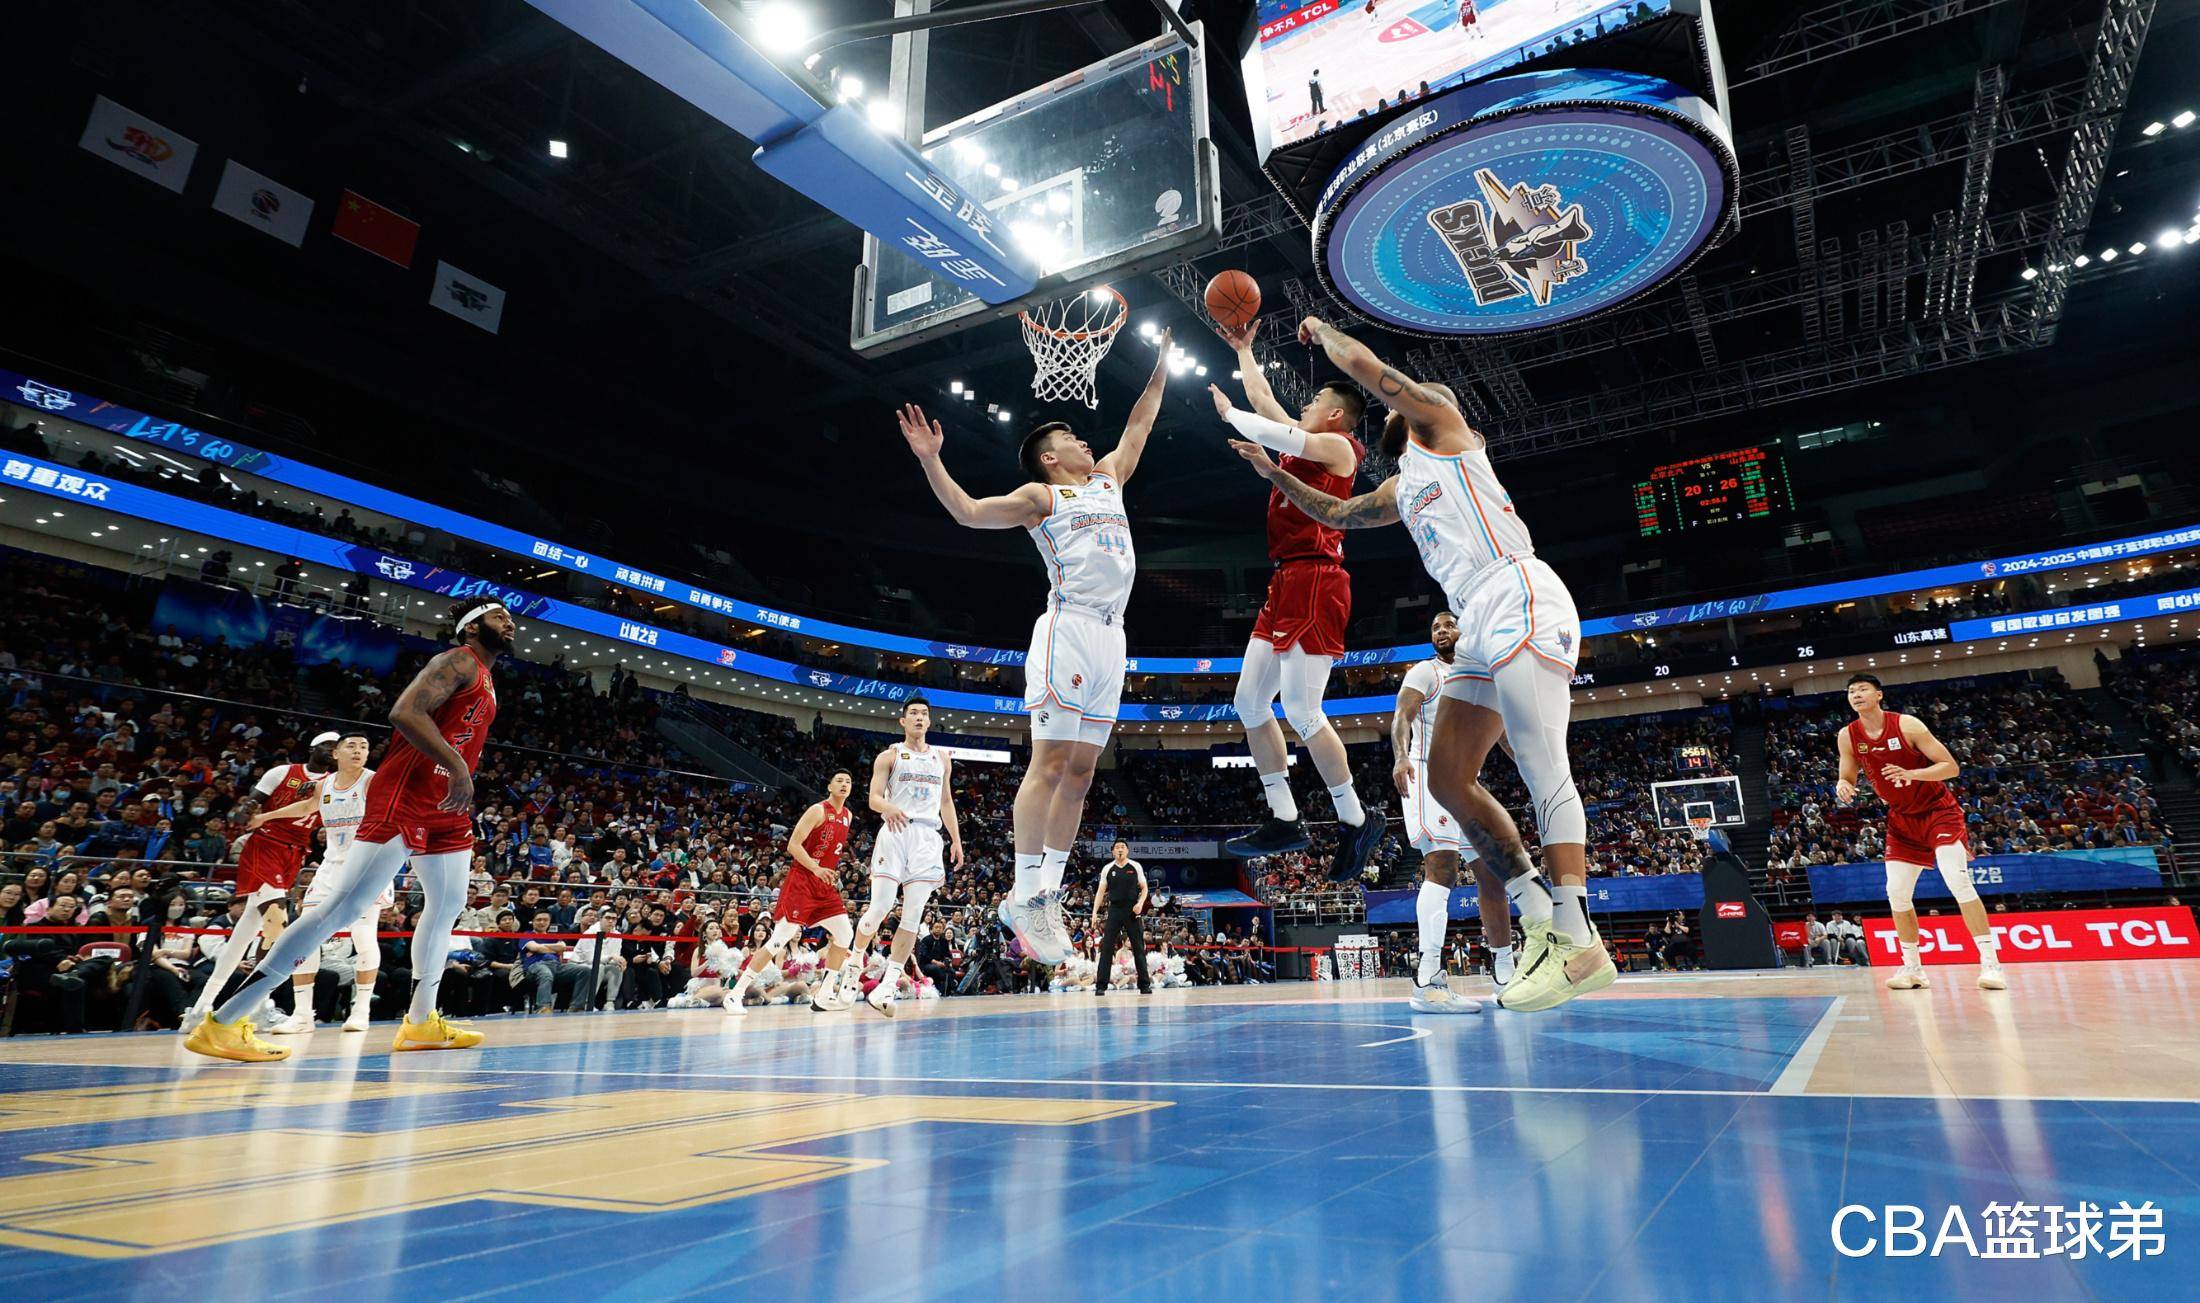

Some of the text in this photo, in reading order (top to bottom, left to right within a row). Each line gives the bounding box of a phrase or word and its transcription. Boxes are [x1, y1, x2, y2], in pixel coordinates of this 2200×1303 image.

[1301, 2, 1332, 20] TCL
[1431, 201, 1526, 304] DUCKS
[126, 416, 233, 460] LET'S GO
[2, 458, 112, 502] 尊重观众
[1684, 485, 1702, 496] 20
[1720, 478, 1738, 490] 26
[1096, 528, 1127, 555] 44
[532, 541, 589, 569] 团结一心
[2002, 552, 2076, 573] 2024-2025
[615, 567, 666, 592] 顽强拼搏
[689, 590, 733, 613] 奋勇争先
[1688, 600, 1746, 621] LET'S GO
[756, 609, 801, 629] 不负使命
[1991, 605, 2121, 633] 爱国敬业奋发图强
[1894, 628, 1948, 645] 山东高速
[992, 650, 1024, 664] LET'S
[1362, 652, 1377, 664] GO
[1731, 656, 1739, 666] 1
[1797, 646, 1815, 658] 26
[1569, 673, 1594, 685] 北汽
[1655, 665, 1670, 677] 20
[854, 679, 904, 700] LET'S GO
[1687, 757, 1702, 768] 14
[2086, 919, 2190, 947] TCL
